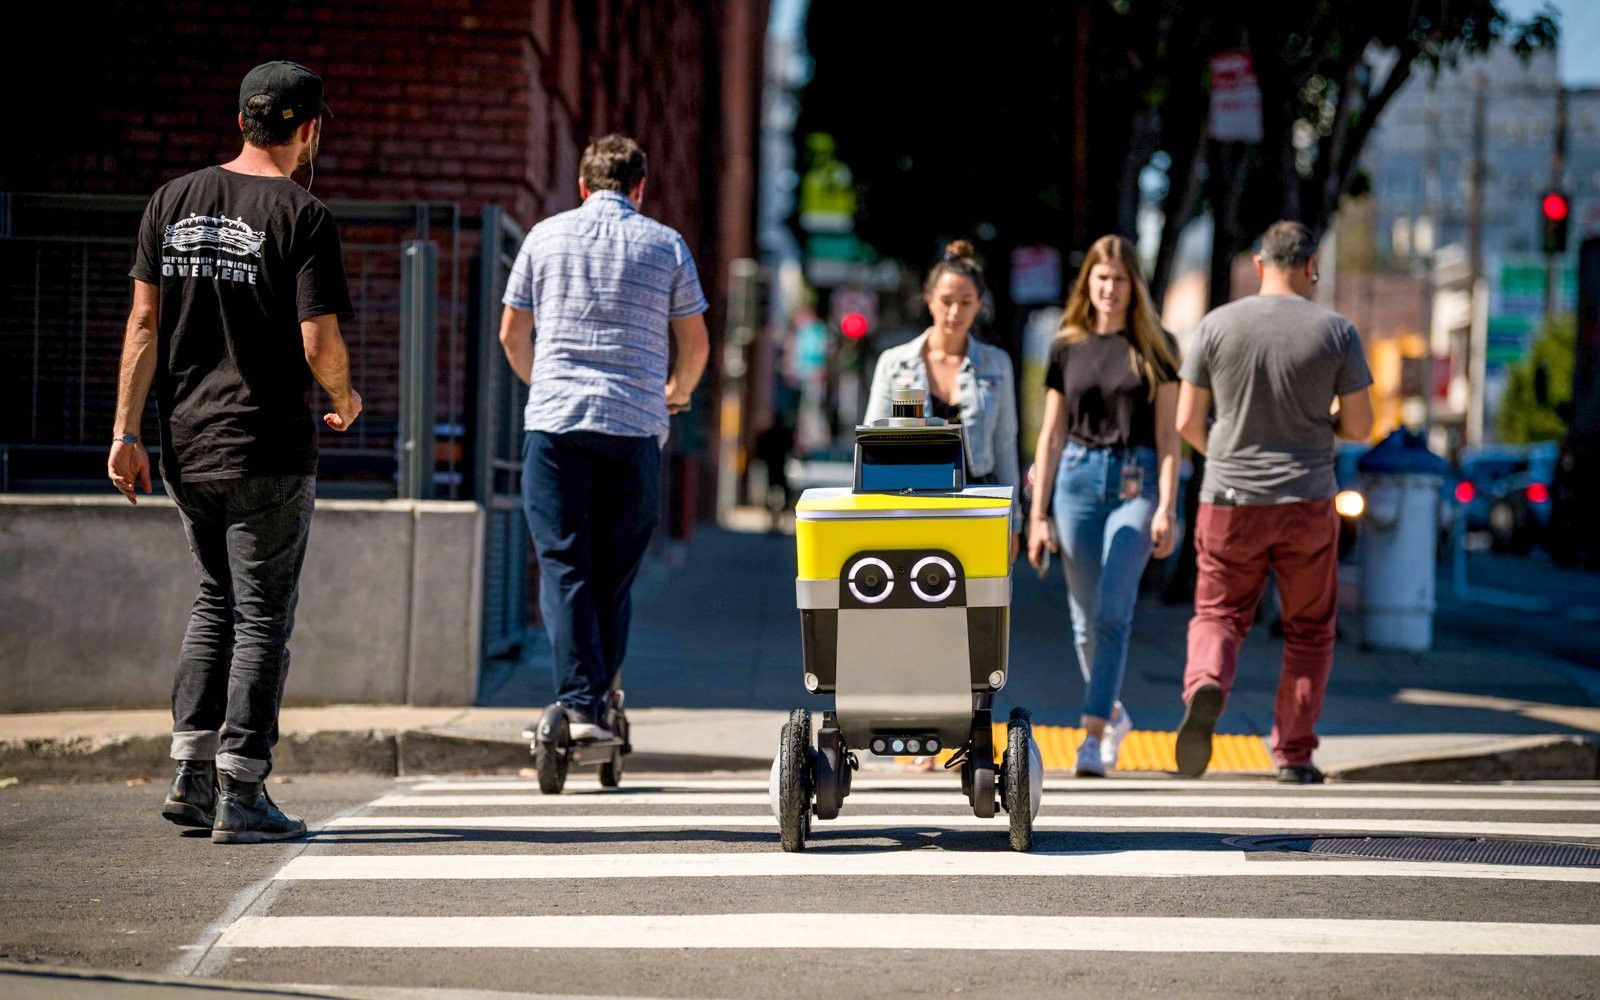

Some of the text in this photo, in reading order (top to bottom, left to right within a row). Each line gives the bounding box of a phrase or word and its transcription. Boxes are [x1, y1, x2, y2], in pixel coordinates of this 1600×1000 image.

[162, 256, 188, 264] WE'RE
[162, 264, 257, 285] OVER ERE
